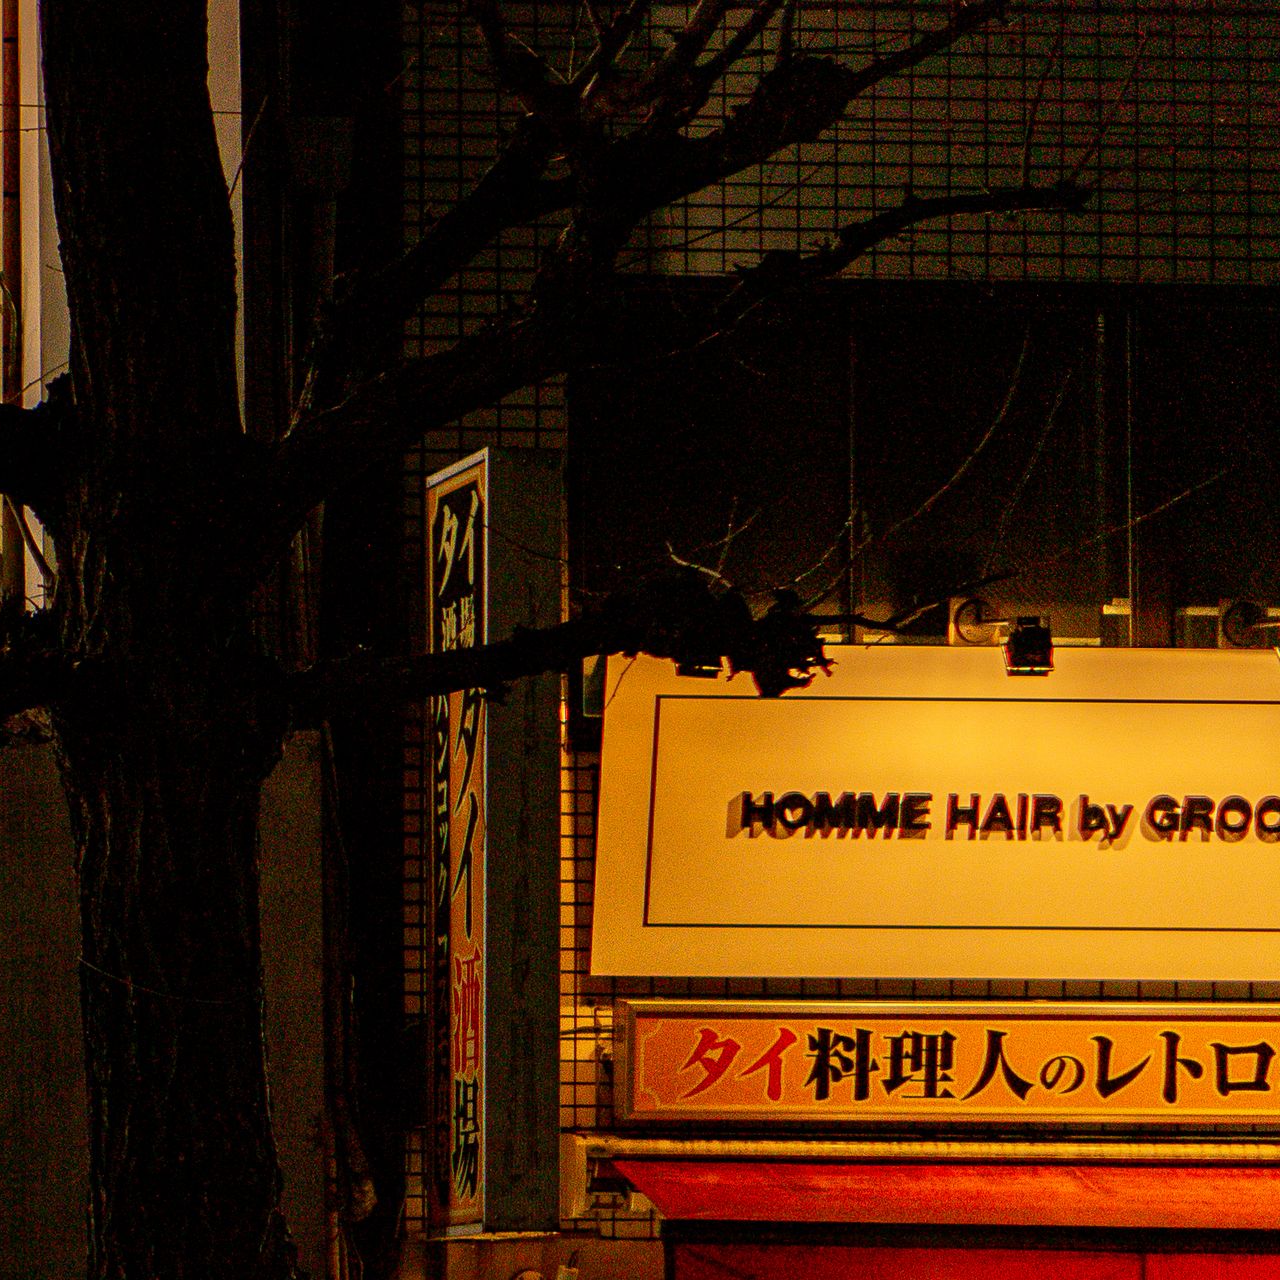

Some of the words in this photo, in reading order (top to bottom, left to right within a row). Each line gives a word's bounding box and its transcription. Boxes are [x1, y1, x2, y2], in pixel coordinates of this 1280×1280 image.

[739, 790, 932, 833] HOMME
[946, 792, 1063, 834] HAIR
[1078, 794, 1133, 841] by
[680, 1027, 1277, 1105] タイ料理人のレトロ
